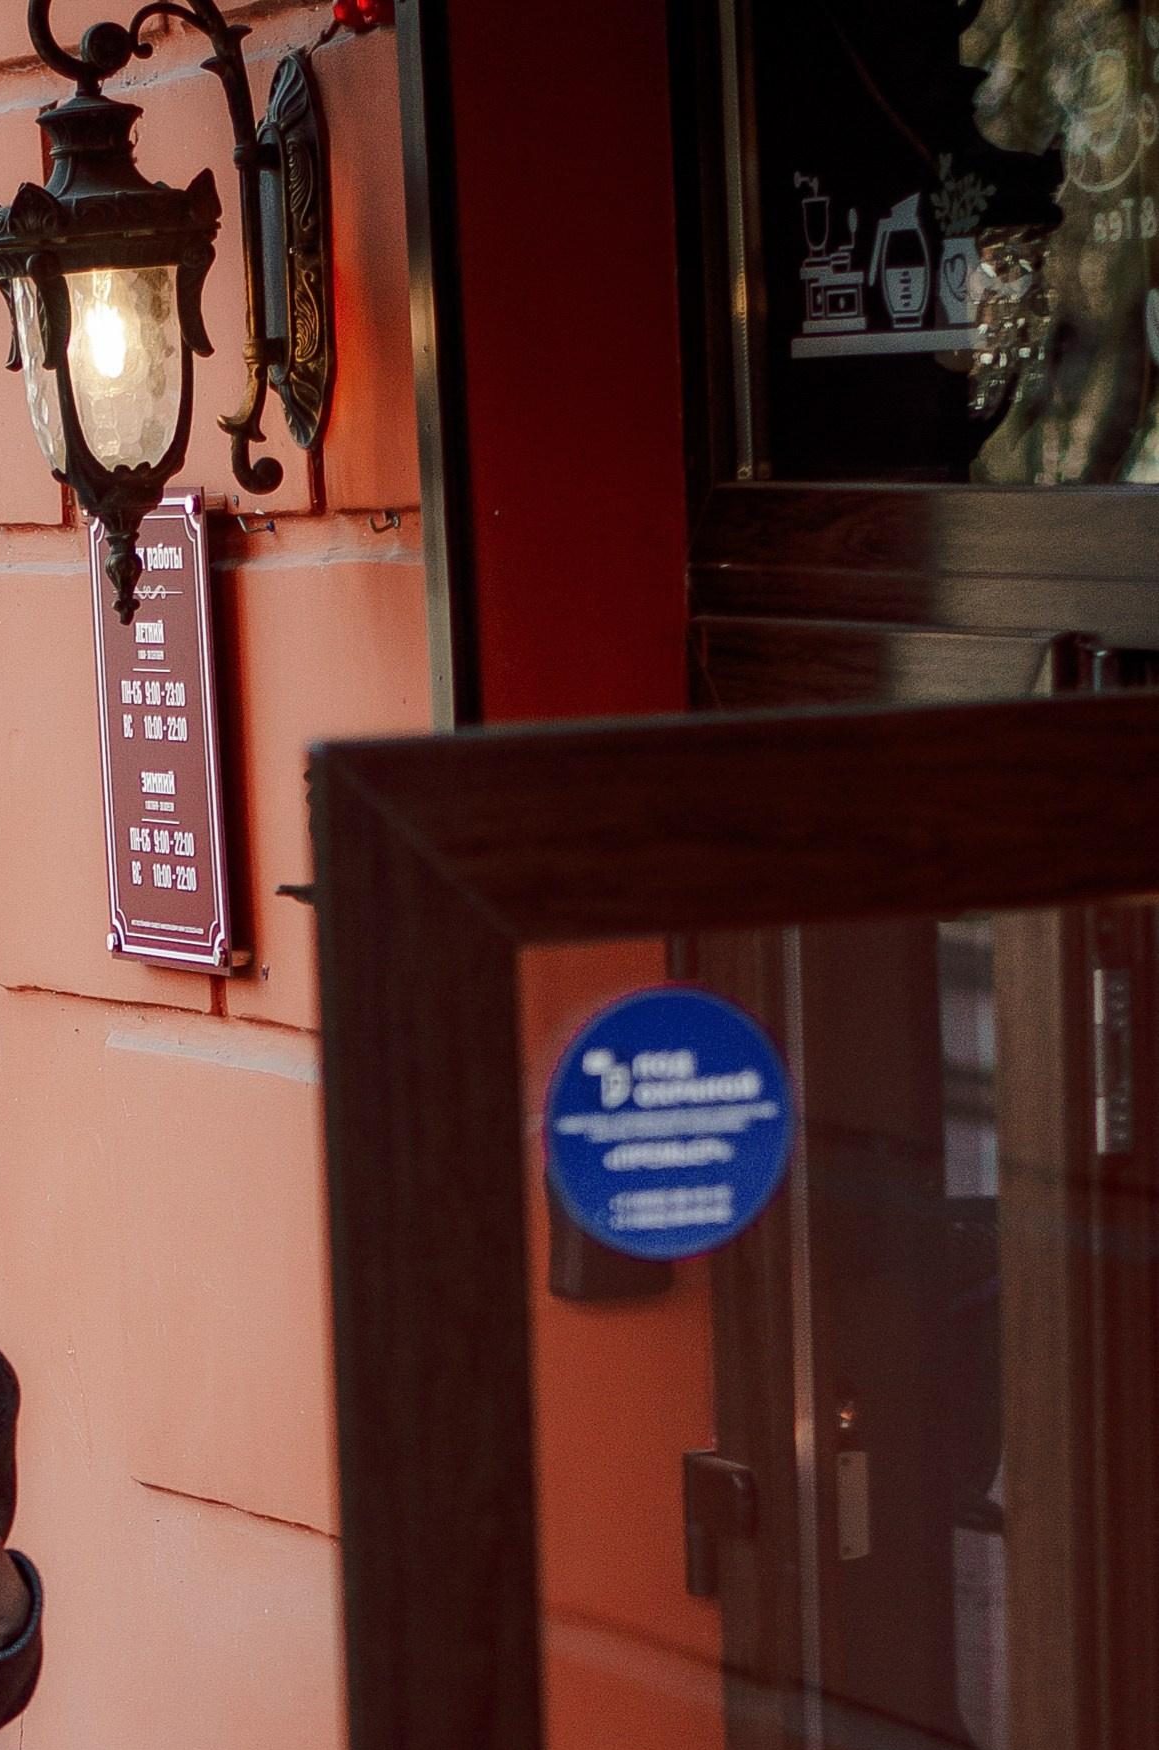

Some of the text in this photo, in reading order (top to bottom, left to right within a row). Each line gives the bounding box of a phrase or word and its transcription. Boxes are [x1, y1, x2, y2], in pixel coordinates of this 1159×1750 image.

[146, 543, 183, 571] работы
[123, 714, 133, 738] ВС
[132, 861, 142, 885] ВС
